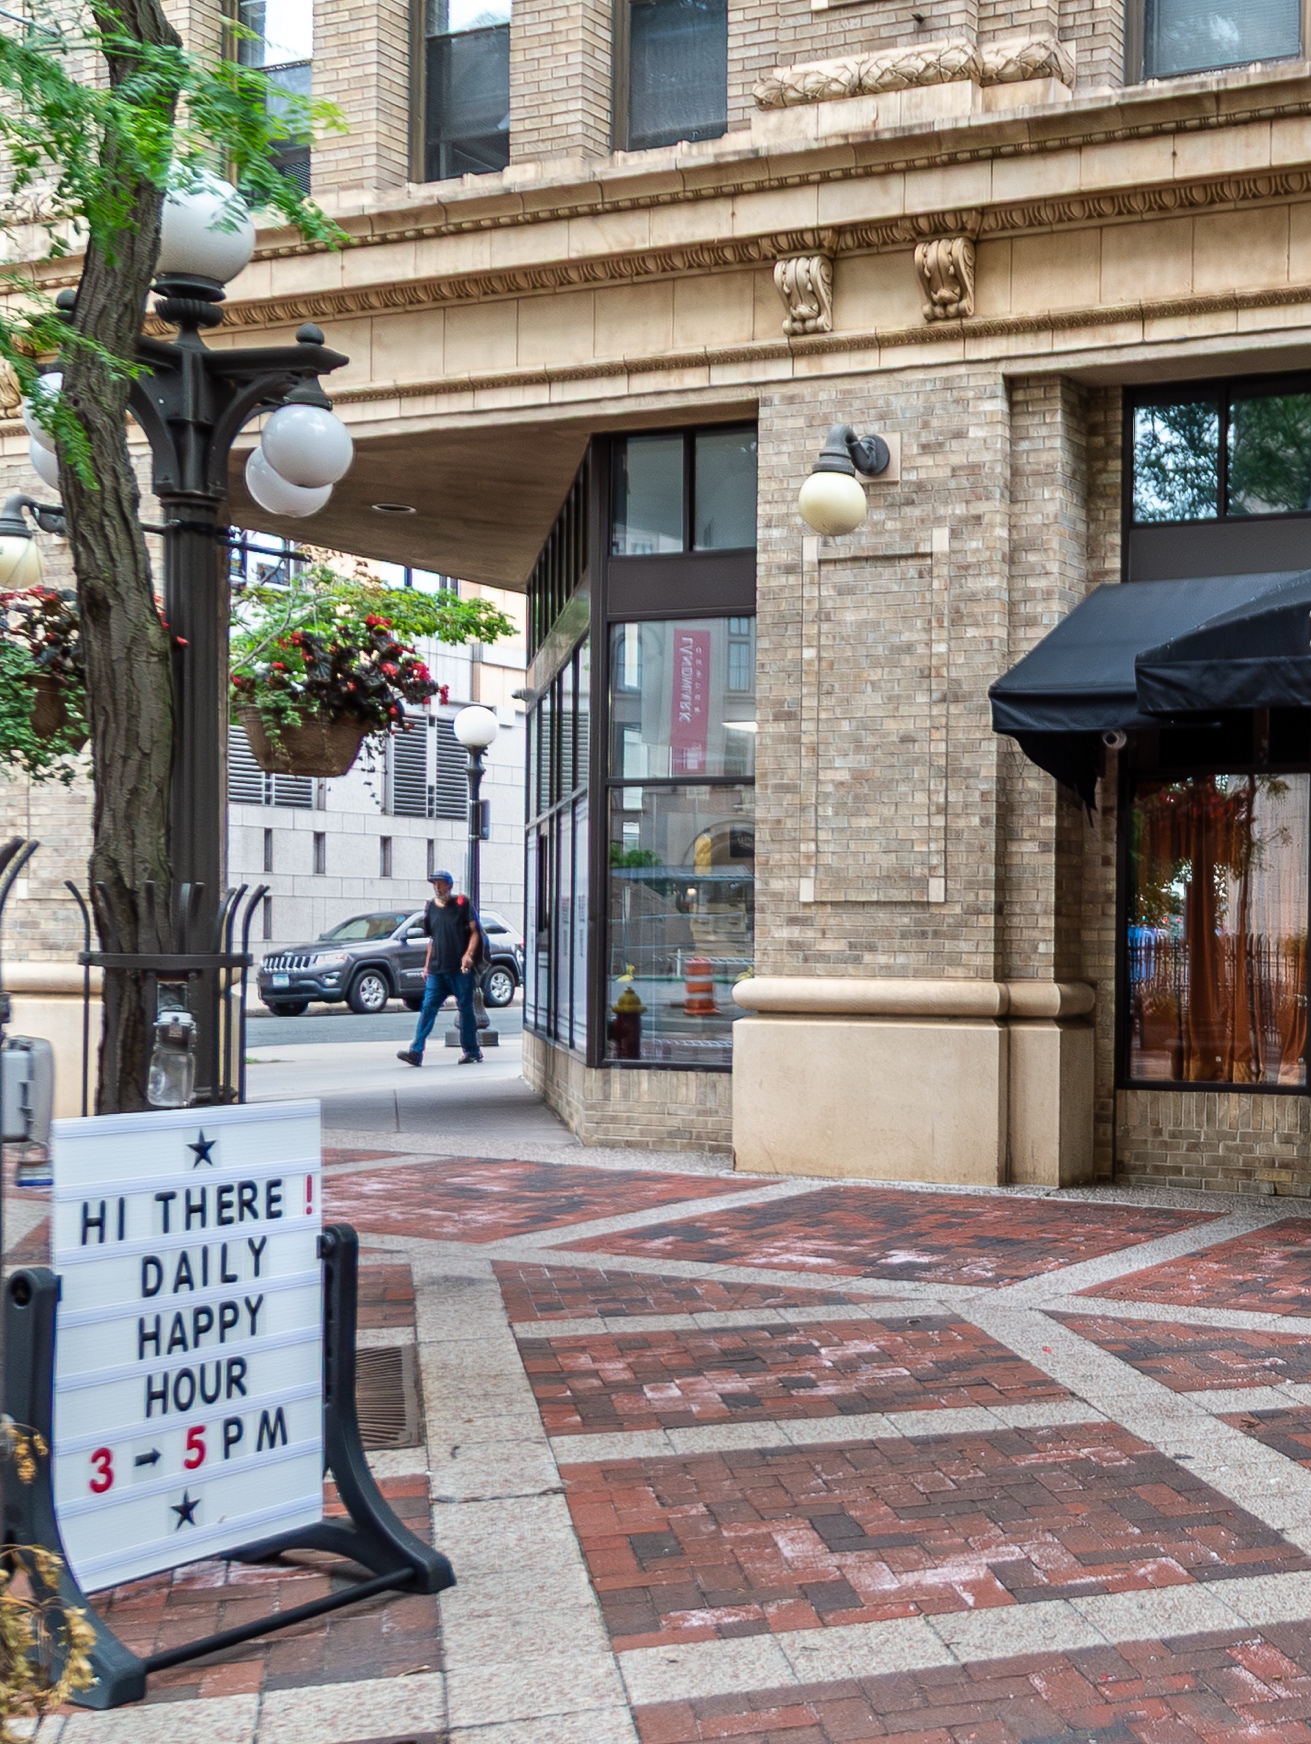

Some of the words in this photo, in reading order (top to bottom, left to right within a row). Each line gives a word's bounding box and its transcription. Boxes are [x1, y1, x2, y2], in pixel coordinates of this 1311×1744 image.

[81, 1197, 126, 1246] HI
[142, 1235, 267, 1298] DAILY
[138, 1295, 264, 1360] HAPPY
[145, 1357, 247, 1418] HOUR
[89, 1447, 114, 1494] 3
